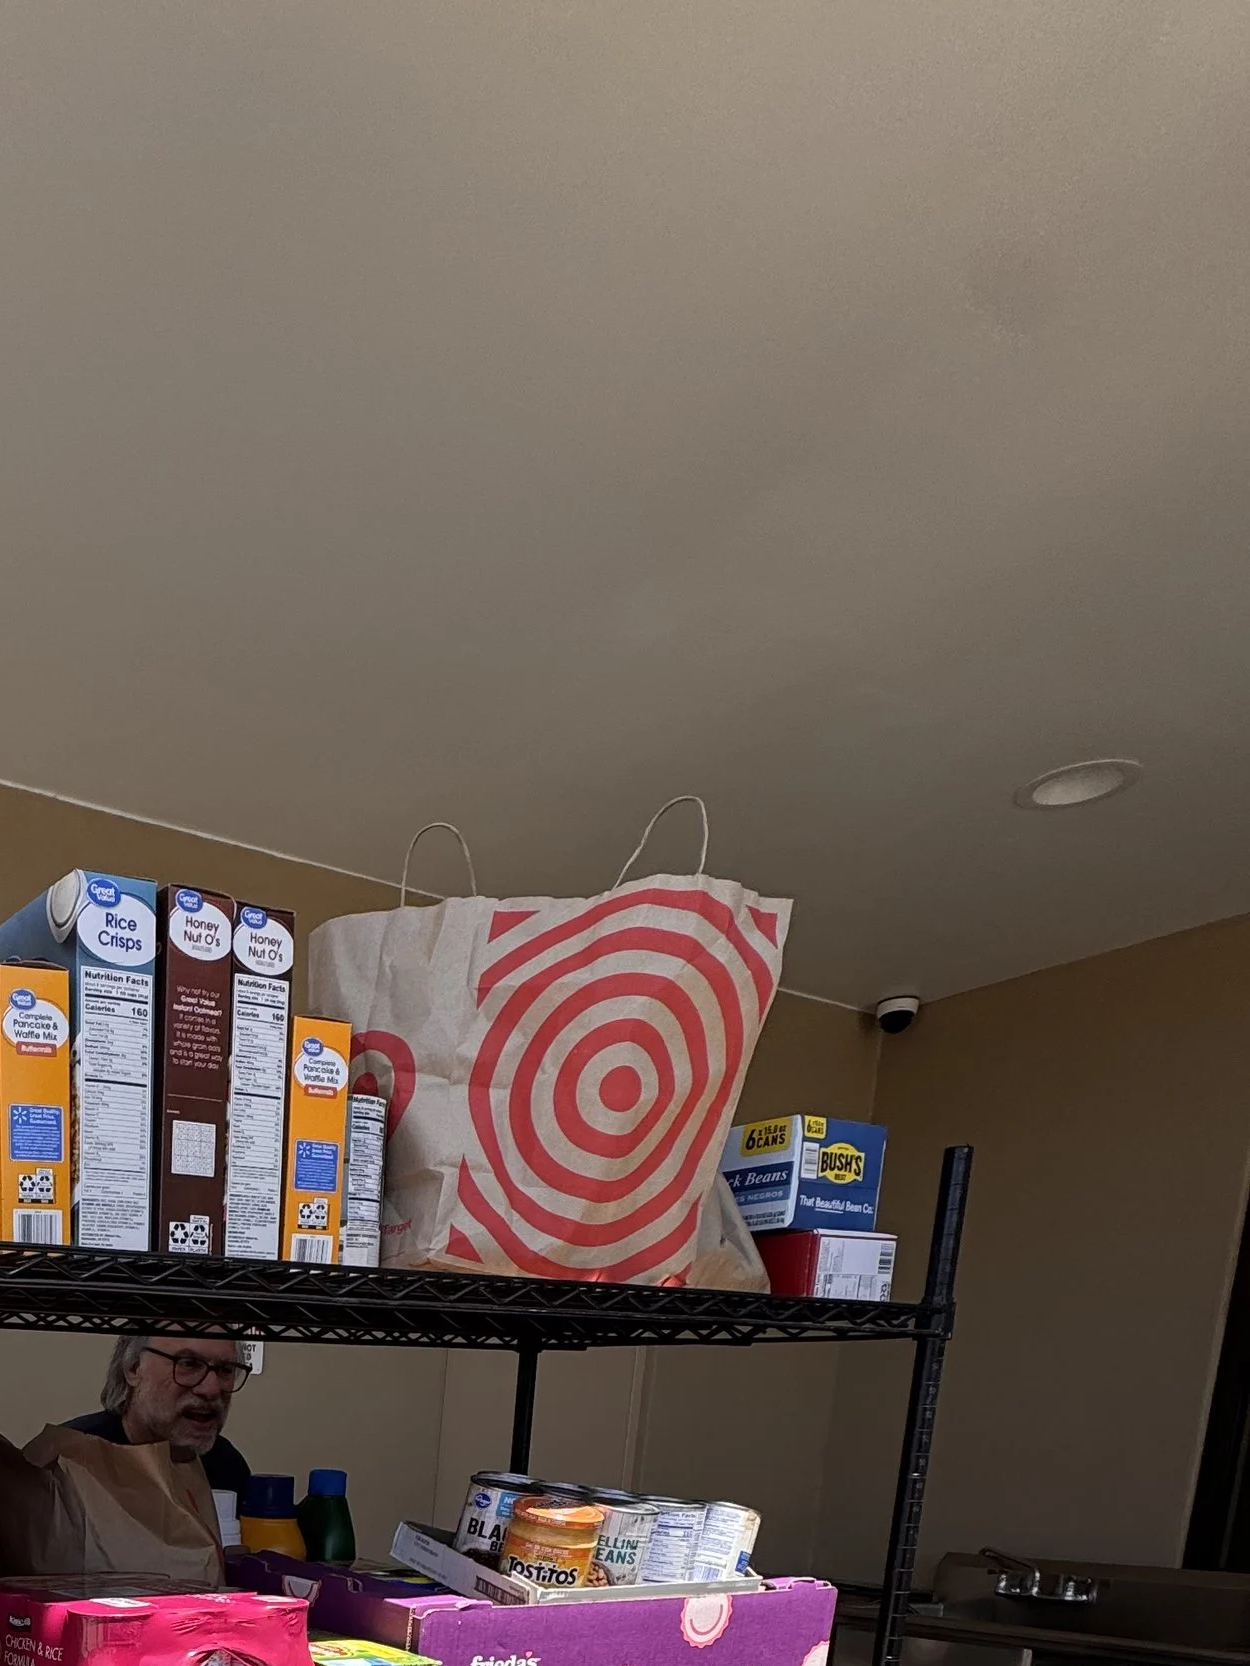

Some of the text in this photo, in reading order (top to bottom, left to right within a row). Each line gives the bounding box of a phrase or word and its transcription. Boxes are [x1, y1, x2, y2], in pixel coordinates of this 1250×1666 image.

[90, 884, 115, 896] Great
[105, 912, 137, 932] Rice
[186, 916, 219, 937] Honey
[98, 930, 142, 953] Crisps
[184, 931, 220, 947] Nut O's
[250, 932, 282, 949] Honey
[248, 945, 265, 959] Nut
[84, 970, 149, 987] Nutrition Facts
[19, 1011, 53, 1022] Complete
[85, 1003, 148, 1018] Calories 160
[13, 1019, 50, 1031] Pancake
[14, 1029, 58, 1041] Waffle Mix
[303, 1064, 334, 1075] Pancake
[303, 1072, 326, 1083] Waffle
[746, 1129, 755, 1151] 6
[756, 1133, 787, 1148] CANS
[820, 1151, 862, 1177] BUSH'S
[745, 1169, 789, 1186] Beans
[748, 1189, 783, 1201] NEGROS
[799, 1194, 862, 1212] That Beautiful Bean
[5, 1633, 63, 1662] CHICKEN & RICE
